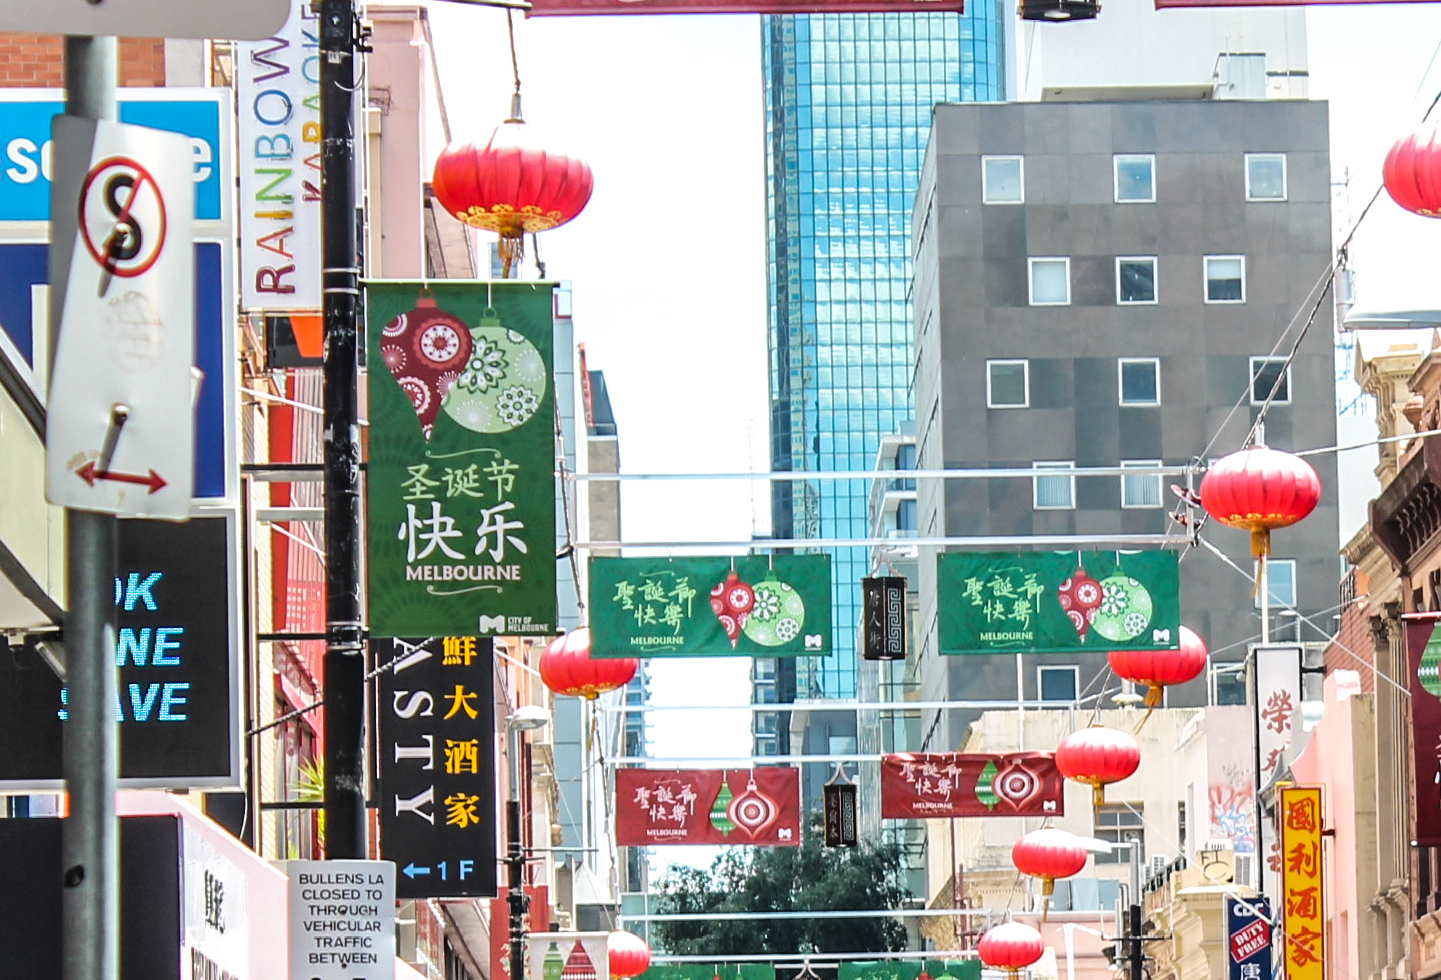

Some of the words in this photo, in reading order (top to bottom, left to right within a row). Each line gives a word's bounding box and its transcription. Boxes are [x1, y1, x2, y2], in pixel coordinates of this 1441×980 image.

[252, 37, 295, 294] RAINBOW
[401, 459, 519, 501] 圣诞节
[398, 501, 528, 563] 快乐
[406, 565, 521, 580] MELBOURNE
[630, 636, 684, 645] MELBOURNE
[980, 632, 1034, 641] MELBOURNE
[299, 874, 364, 885] BULLENS
[368, 874, 384, 885] LA
[302, 889, 360, 900] CLOSED
[366, 889, 383, 900] TO
[308, 905, 378, 916] THROUGH
[303, 921, 381, 932] VEHICULAR
[1235, 922, 1264, 946] DUTY
[314, 937, 372, 948] TRAFFIC
[1237, 934, 1266, 957] FREE
[309, 953, 377, 964] BETWEEN
